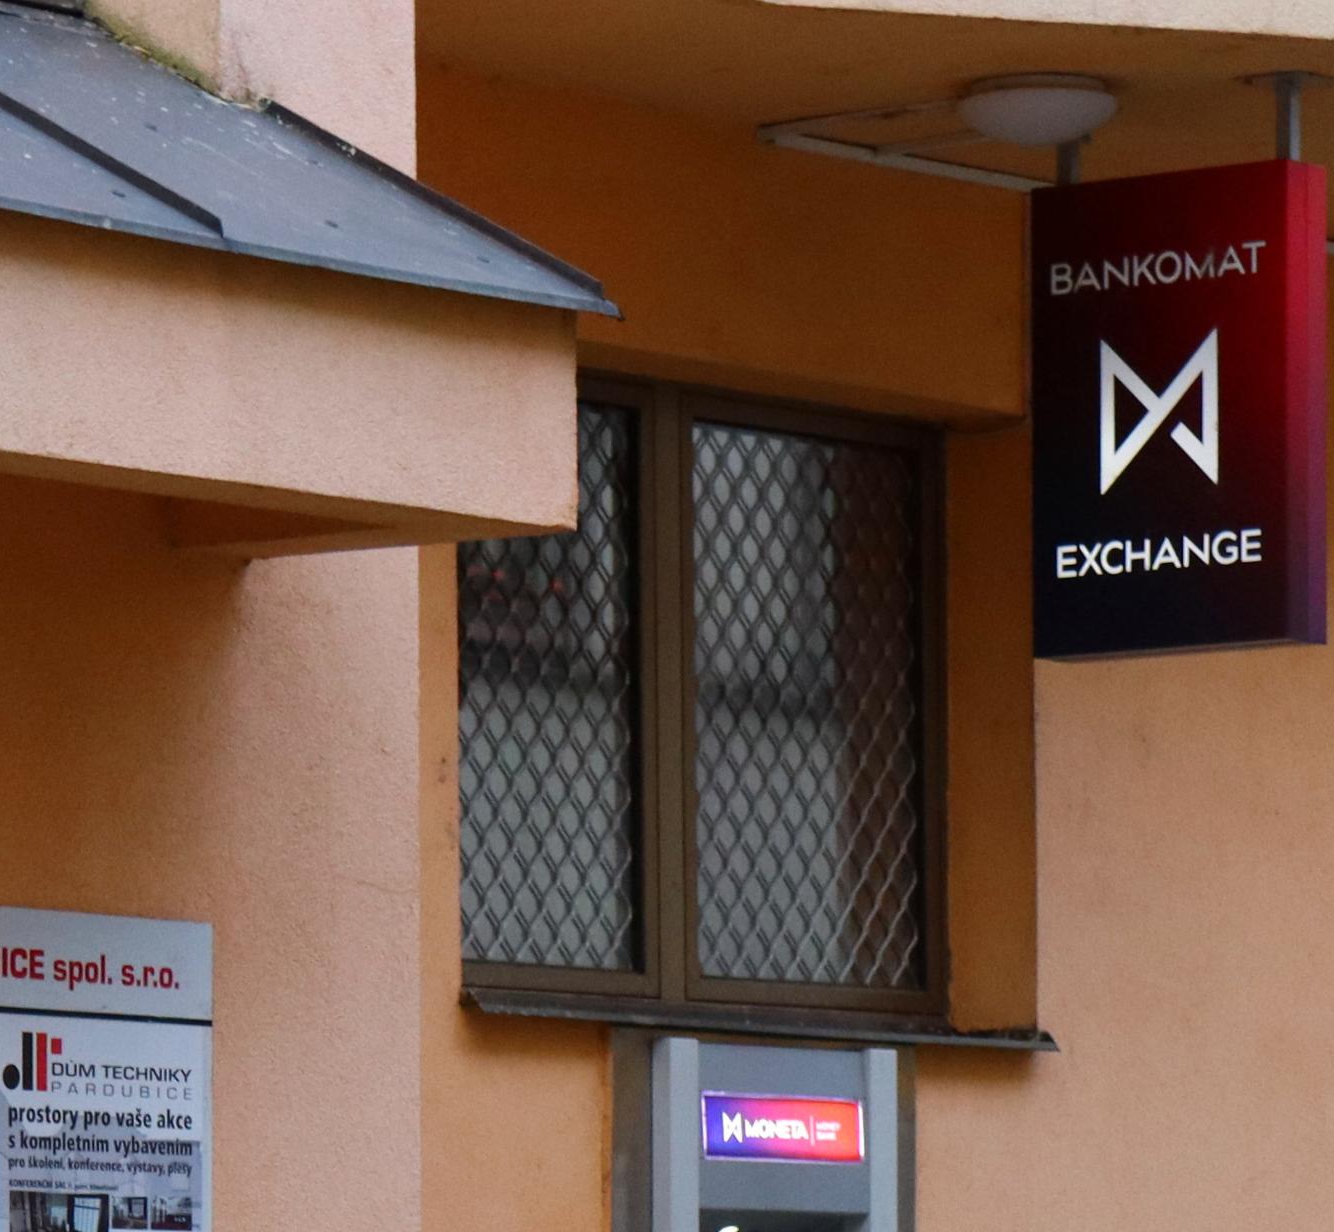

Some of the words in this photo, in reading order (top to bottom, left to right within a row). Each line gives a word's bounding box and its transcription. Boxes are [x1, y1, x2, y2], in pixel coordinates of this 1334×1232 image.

[1050, 240, 1266, 296] BANKOMAT
[1056, 528, 1263, 579] EXCHANGE
[53, 954, 113, 992] spol.
[121, 964, 180, 990] s.r.o.
[51, 1060, 96, 1079] DŮM
[102, 1065, 193, 1083] TECHNIKY
[51, 1081, 193, 1100] PARDUBICE
[8, 1105, 79, 1130] prostory
[84, 1110, 111, 1130] pro
[116, 1108, 152, 1128] vaše
[157, 1109, 193, 1129] akce
[744, 1118, 810, 1140] MONETA
[8, 1135, 15, 1149] s
[20, 1130, 110, 1154] kompletním
[114, 1135, 193, 1158] vybavením
[8, 1158, 25, 1171] pro
[68, 1158, 125, 1173] konference,
